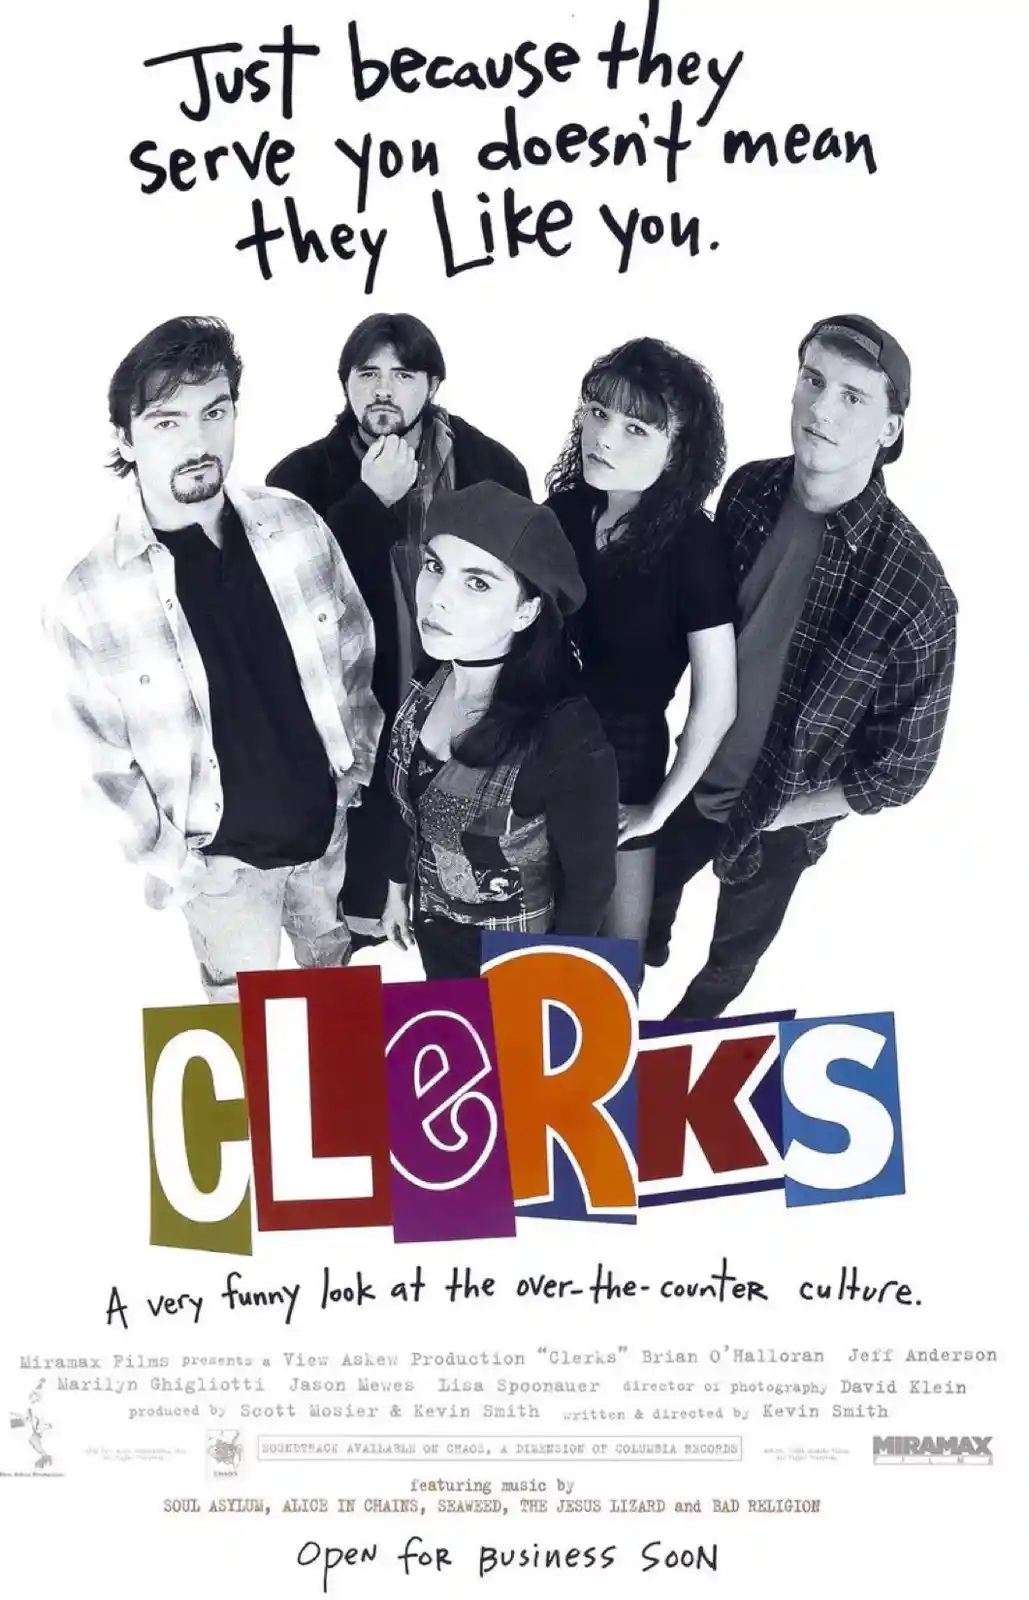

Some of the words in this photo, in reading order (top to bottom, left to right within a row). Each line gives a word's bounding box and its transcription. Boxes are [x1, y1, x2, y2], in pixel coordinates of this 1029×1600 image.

[144, 25, 320, 121] Just
[348, 20, 580, 101] because
[598, 0, 743, 127] they
[130, 131, 296, 194] serve
[335, 133, 438, 213] you
[478, 100, 691, 183] doesn't
[724, 124, 877, 174] mean
[235, 196, 387, 294] they
[432, 187, 572, 277] Like
[599, 204, 719, 273] you.
[107, 1287, 128, 1328] A
[148, 1294, 202, 1323] very
[222, 1272, 299, 1324] funny
[322, 1267, 376, 1309] look
[391, 1266, 425, 1302] at
[446, 1267, 494, 1302] the
[800, 1266, 922, 1305] culture.
[19, 1355, 102, 1370] Miramax
[112, 1354, 169, 1369] Films
[181, 1356, 253, 1368] presents
[261, 1358, 271, 1368] a
[282, 1352, 329, 1367] View
[341, 1352, 398, 1367] Askew
[410, 1351, 525, 1367] Production
[641, 1349, 698, 1364] Brian
[709, 1344, 825, 1364] O'Halloran
[847, 1347, 894, 1363] Jeff
[904, 1347, 998, 1363] Anderson
[57, 1376, 138, 1395] Marilyn
[150, 1376, 265, 1395] Ghigliotti
[289, 1377, 346, 1392] Jason
[357, 1377, 415, 1392] Mewes
[437, 1377, 485, 1393] Lisa
[497, 1378, 601, 1396] Spoonauer
[622, 1380, 695, 1392] director
[730, 1380, 827, 1396] photography
[840, 1379, 898, 1395] David
[908, 1379, 967, 1395] Klein
[128, 1404, 200, 1420] produced
[208, 1404, 225, 1419] by
[240, 1403, 296, 1418] Scott
[309, 1403, 379, 1418] Mosier
[389, 1403, 402, 1418] &
[413, 1403, 470, 1419] Kevin
[482, 1403, 541, 1419] Smith
[562, 1408, 626, 1421] written
[634, 1408, 644, 1420] &
[652, 1407, 724, 1420] directed
[732, 1407, 749, 1421] by
[762, 1403, 820, 1419] Kevin
[832, 1403, 889, 1419] Smith
[261, 1443, 338, 1454] SOUNDTRACK
[346, 1442, 416, 1454] AVAILABLE
[422, 1443, 440, 1455] ON
[446, 1443, 491, 1456] CHAOS,
[500, 1443, 509, 1454] A
[515, 1443, 585, 1455] DIMENSION
[591, 1443, 608, 1455] OF
[615, 1443, 678, 1455] COLUMBIA
[684, 1443, 737, 1455] RECORDS
[873, 1436, 993, 1456] MIRAMAX
[410, 1477, 493, 1496] featuring
[500, 1478, 547, 1493] music
[556, 1477, 575, 1496] by
[163, 1498, 202, 1514] SOUL
[208, 1497, 271, 1516] ASYLUM,
[281, 1498, 329, 1513] ALICE
[337, 1498, 356, 1513] IN
[363, 1498, 426, 1516] CHAINS,
[437, 1499, 509, 1516] SEAWEED,
[519, 1498, 548, 1513] THE
[556, 1499, 602, 1514] JESUS
[609, 1498, 666, 1514] LIZARD
[674, 1499, 703, 1514] and
[711, 1498, 740, 1514] BAD
[747, 1498, 822, 1514] RELIGION
